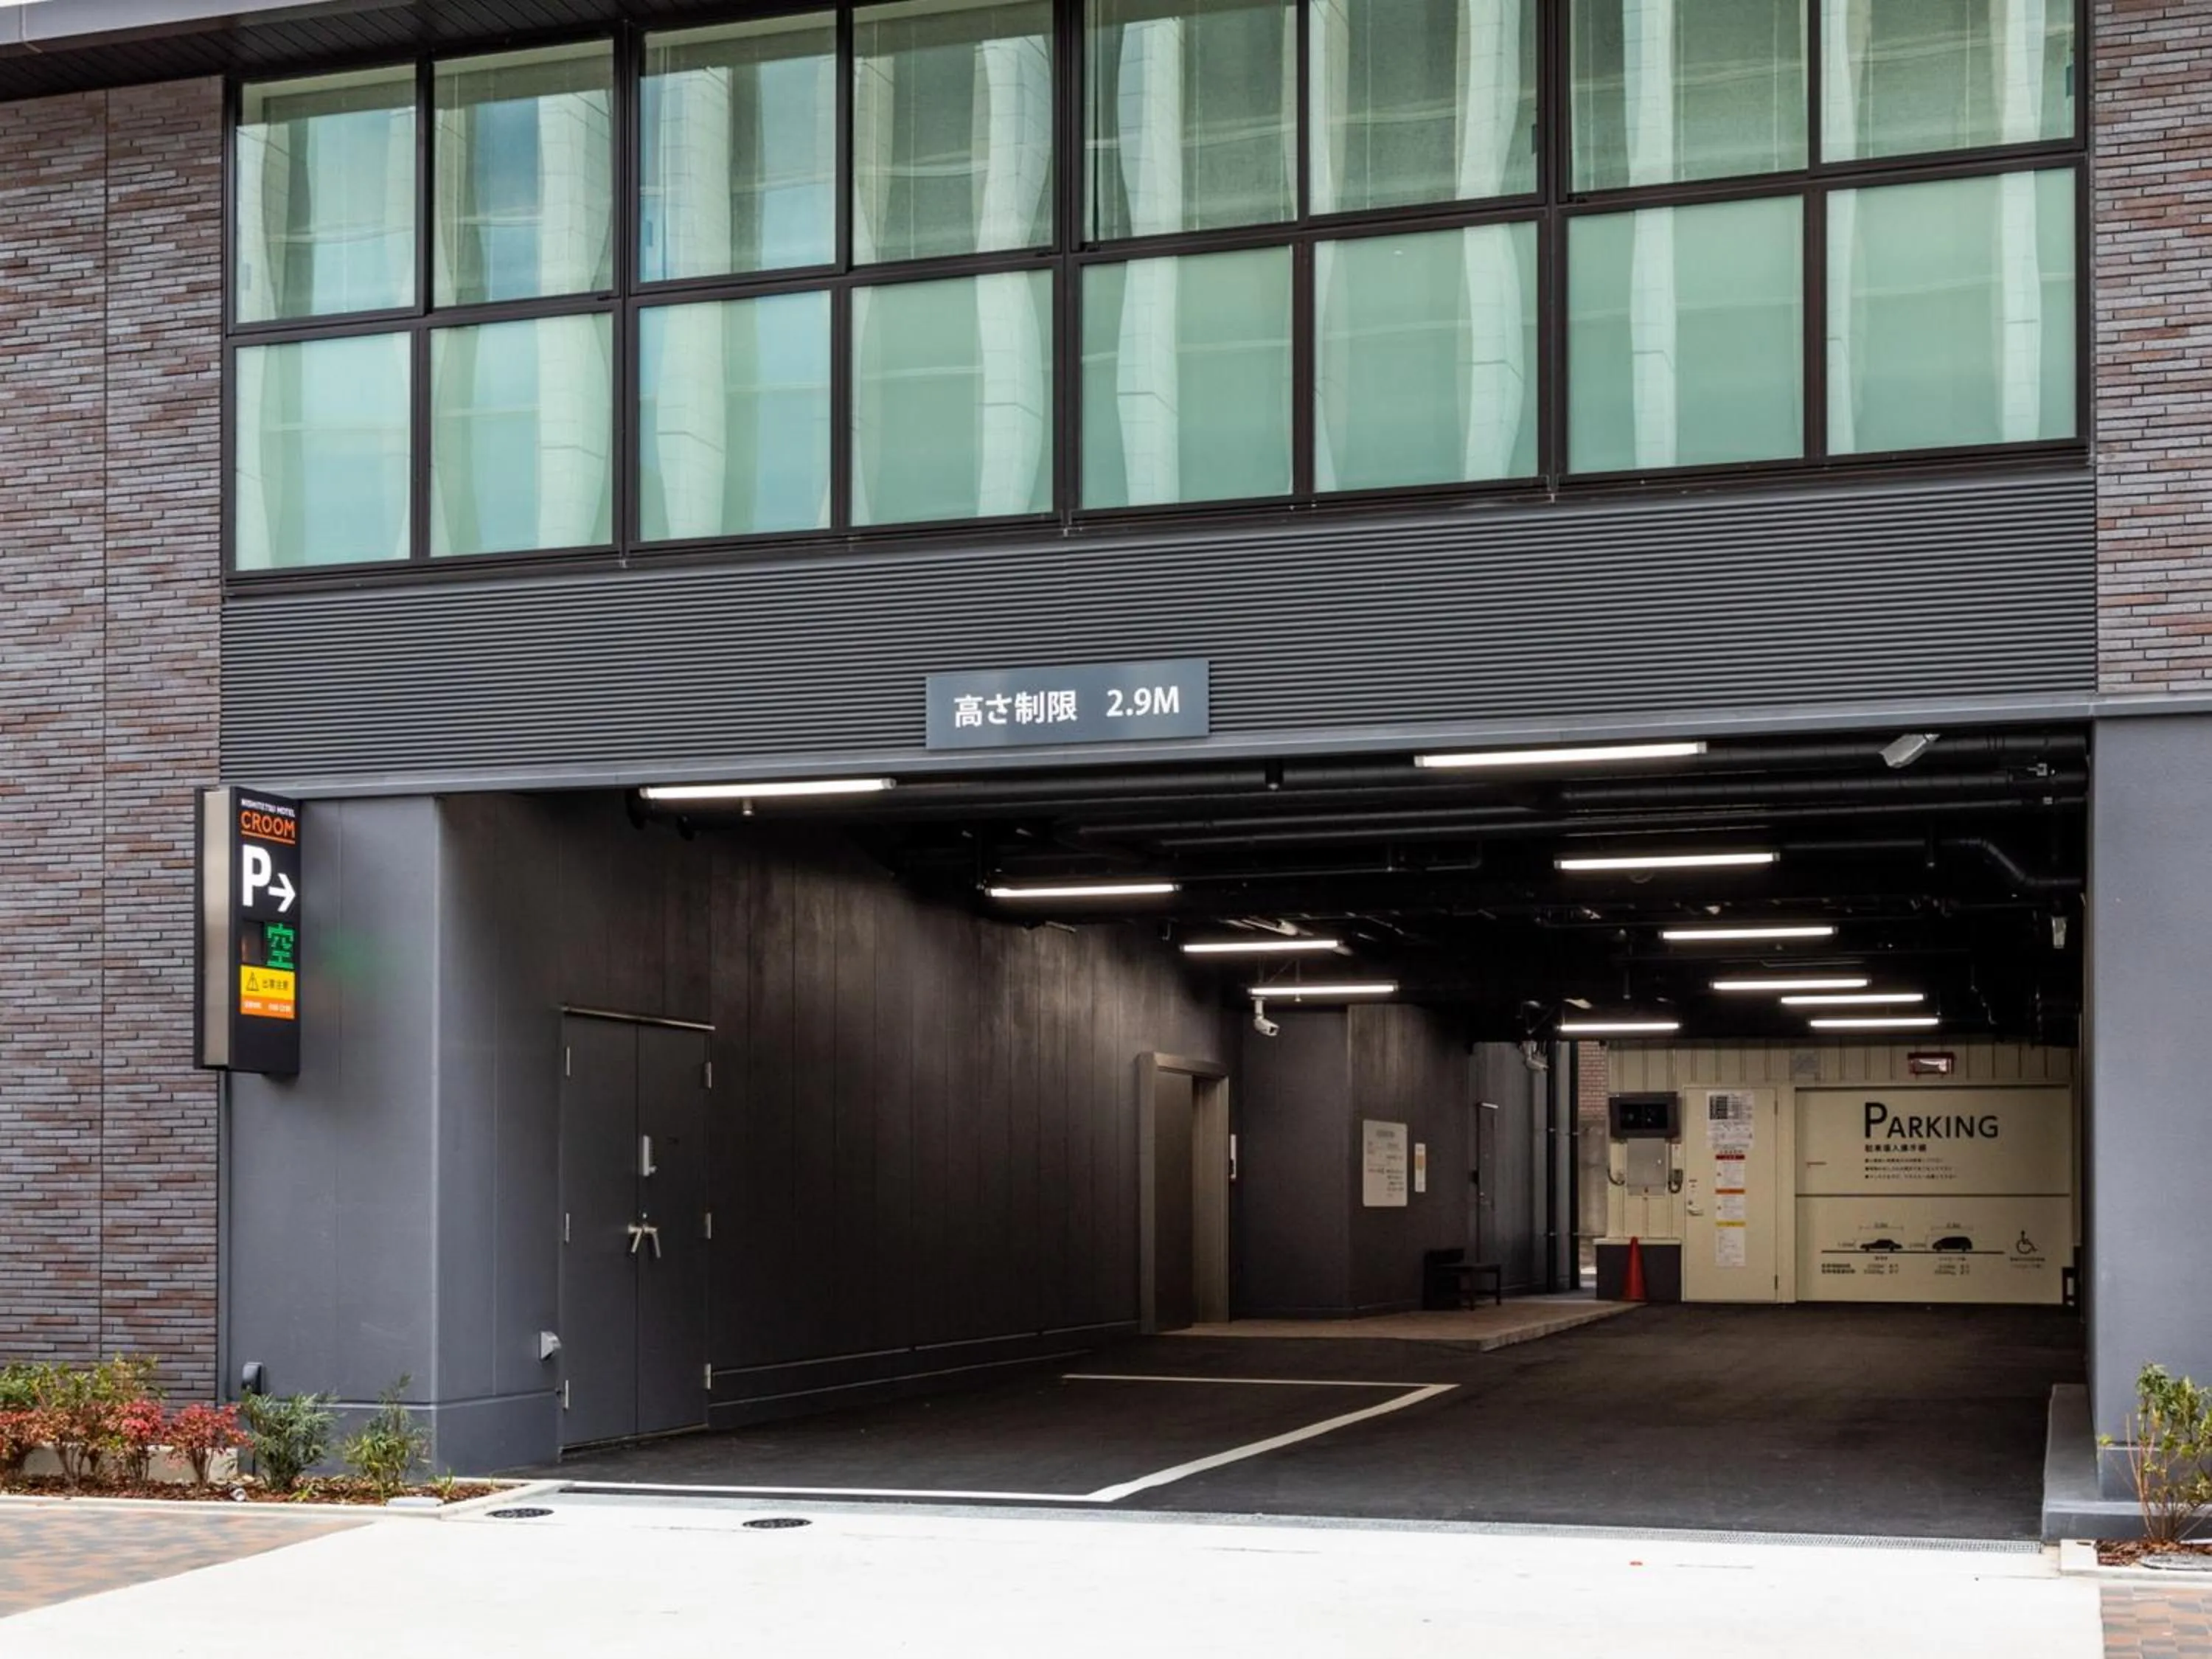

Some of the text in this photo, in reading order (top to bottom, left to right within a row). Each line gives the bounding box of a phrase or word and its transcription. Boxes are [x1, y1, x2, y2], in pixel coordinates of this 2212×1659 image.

[954, 686, 1180, 728] 高さ制限 2.9M
[240, 810, 296, 838] CROOM
[276, 806, 296, 818] HOTEL
[243, 845, 273, 907] P
[266, 922, 294, 970] 空
[1864, 1102, 1999, 1139] PARKING
